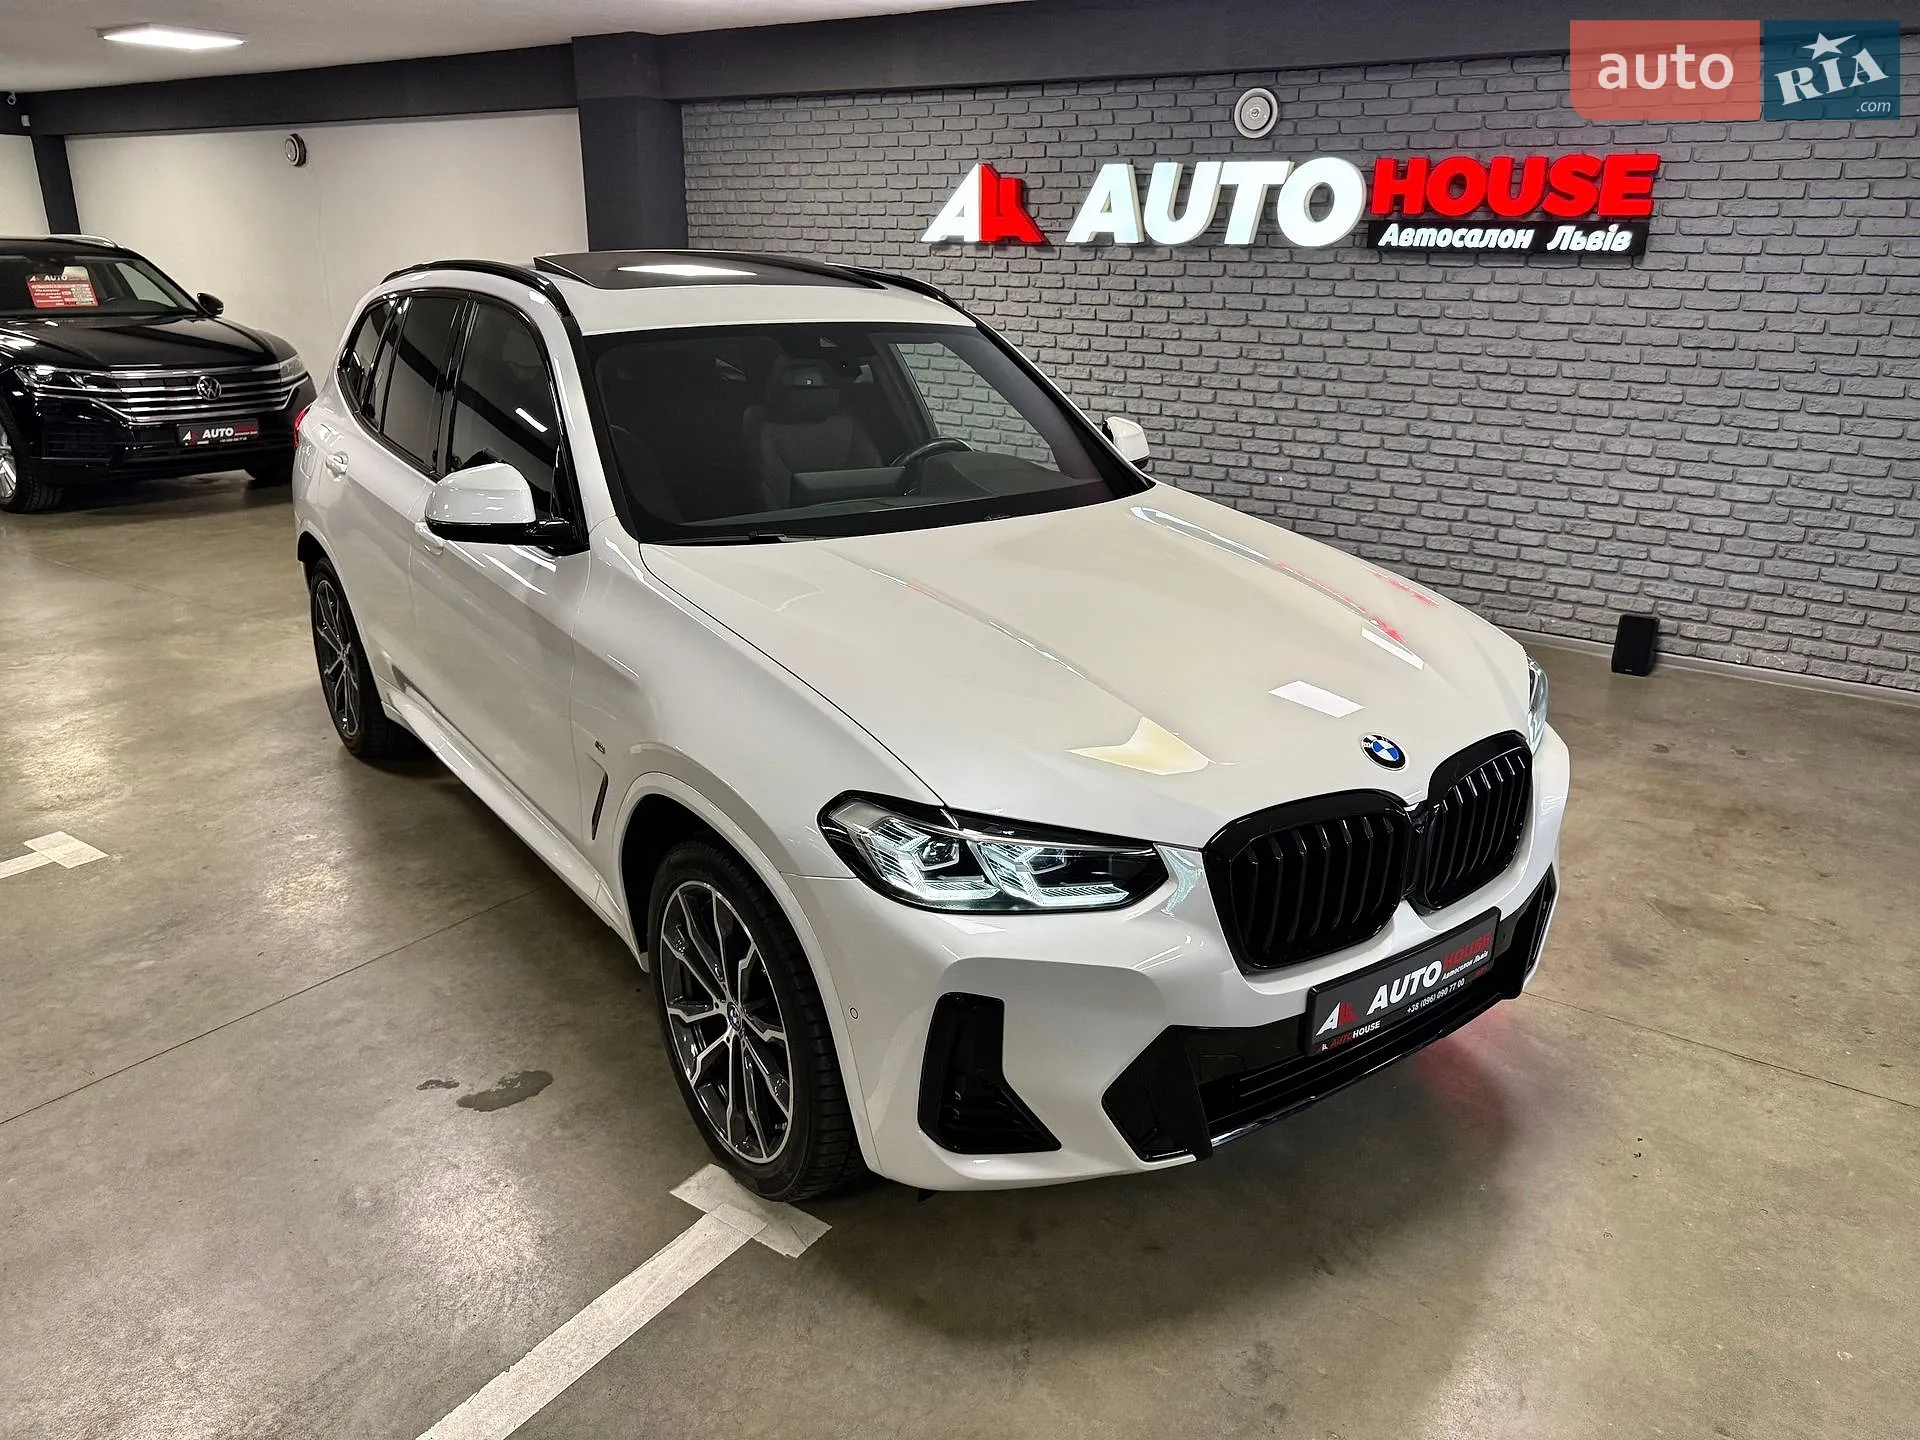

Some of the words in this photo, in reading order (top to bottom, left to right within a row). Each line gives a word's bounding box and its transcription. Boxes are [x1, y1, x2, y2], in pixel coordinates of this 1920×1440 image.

[1065, 157, 1367, 247] AUTO
[1370, 154, 1661, 217] HOUSE
[1378, 223, 1535, 250] Автосалон
[1546, 224, 1634, 252] Львів
[203, 427, 234, 439] AUTO
[1366, 960, 1443, 1016] AUTO
